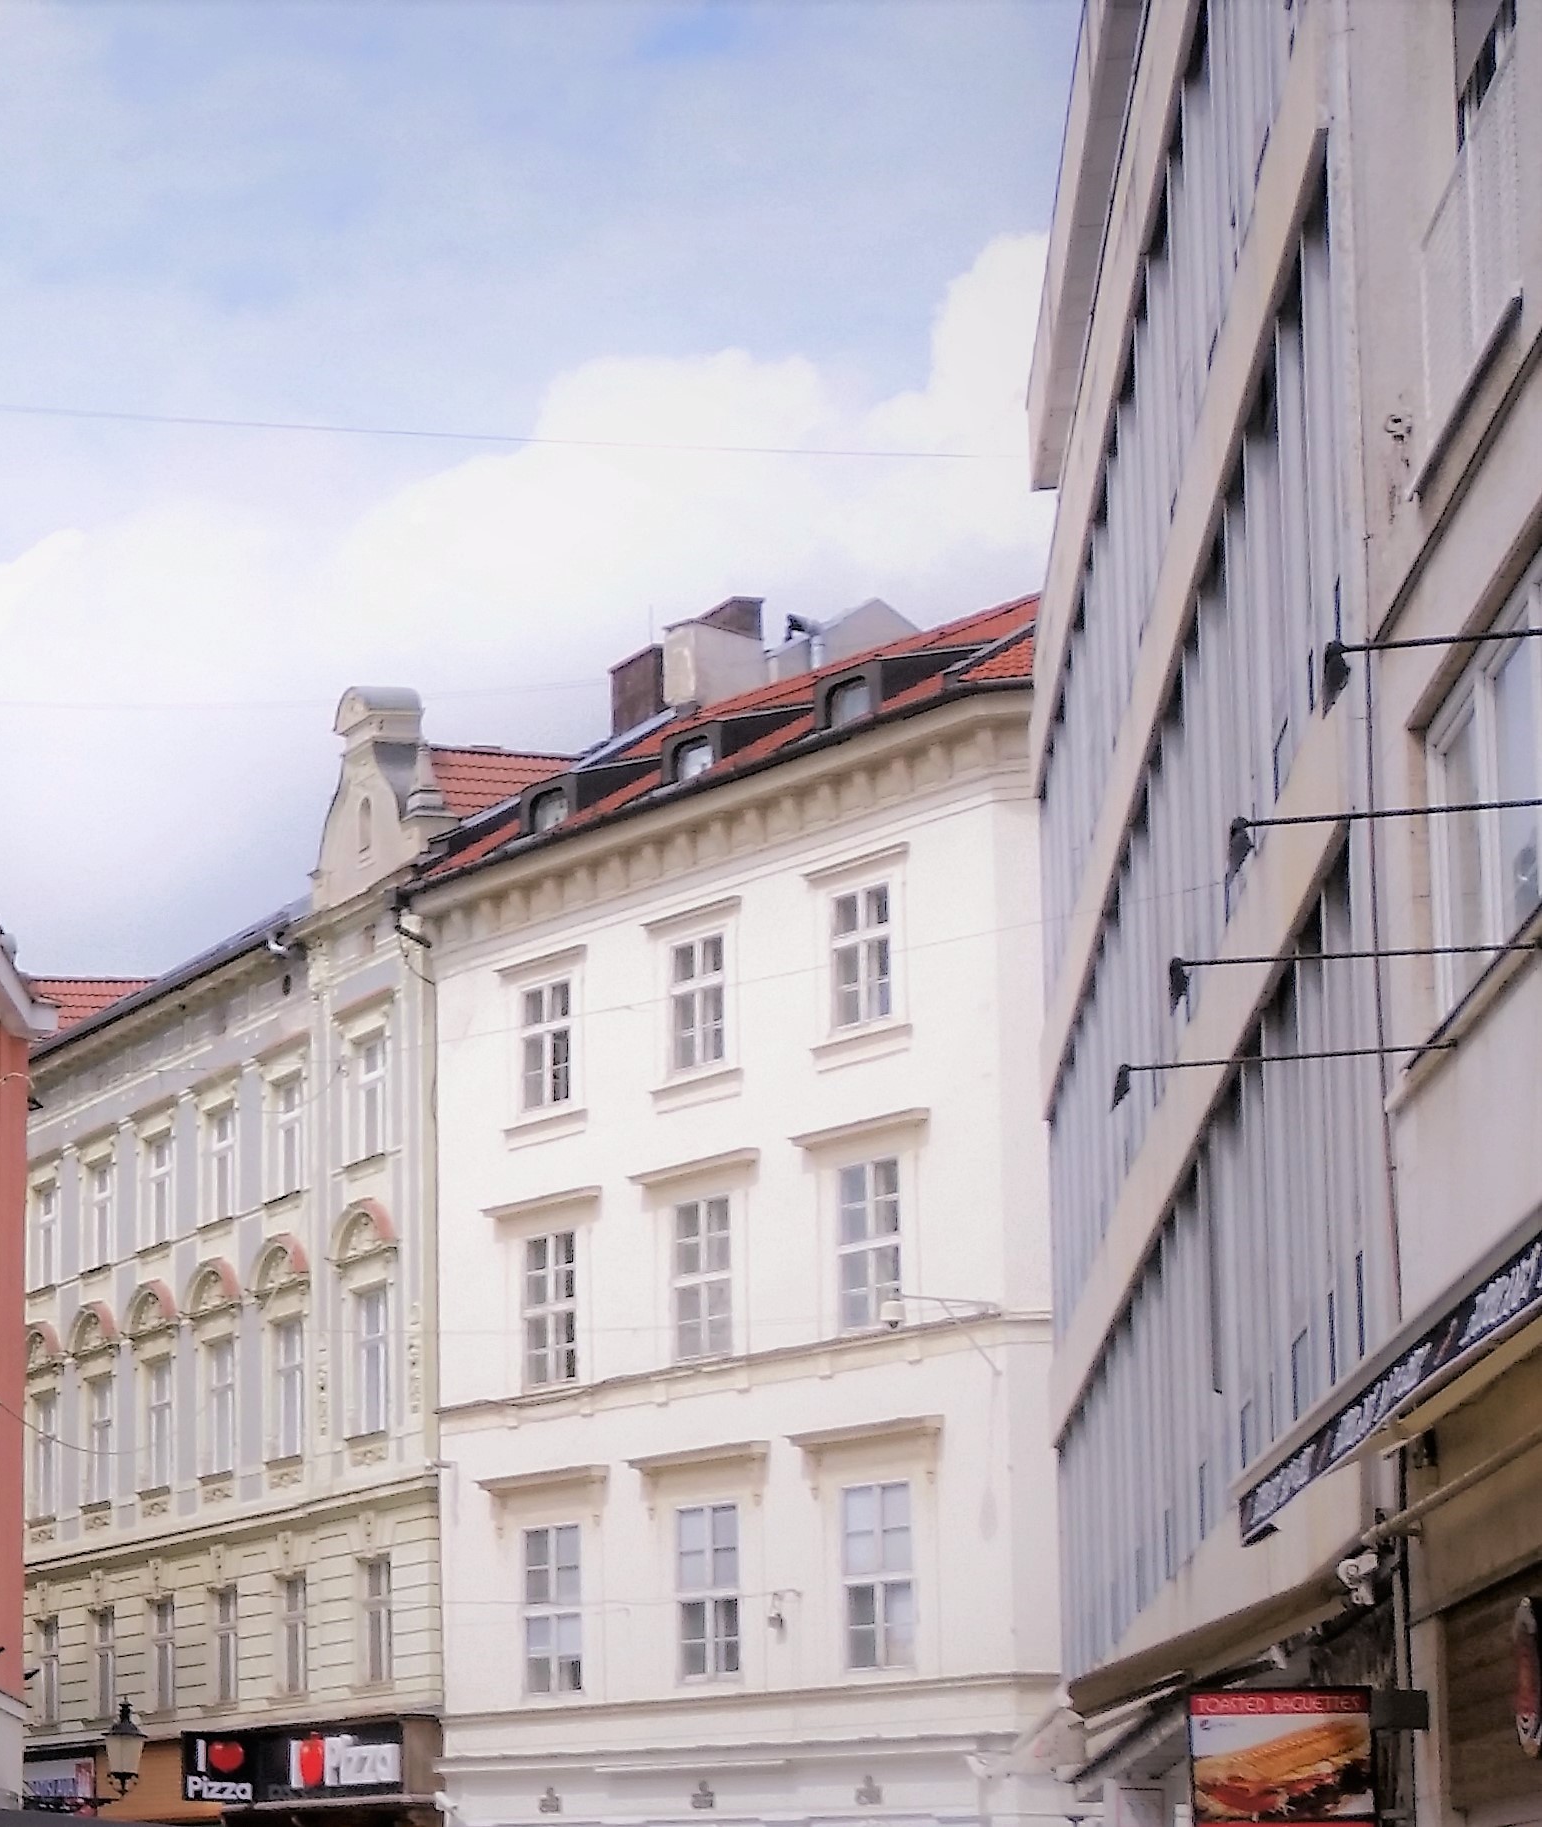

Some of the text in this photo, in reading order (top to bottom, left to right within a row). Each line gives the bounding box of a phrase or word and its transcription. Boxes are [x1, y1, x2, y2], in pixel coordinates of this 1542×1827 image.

[1197, 1695, 1361, 1712] TOASTED BAGUETTES
[324, 1735, 401, 1787] Pizza
[186, 1774, 253, 1800] Pizza
